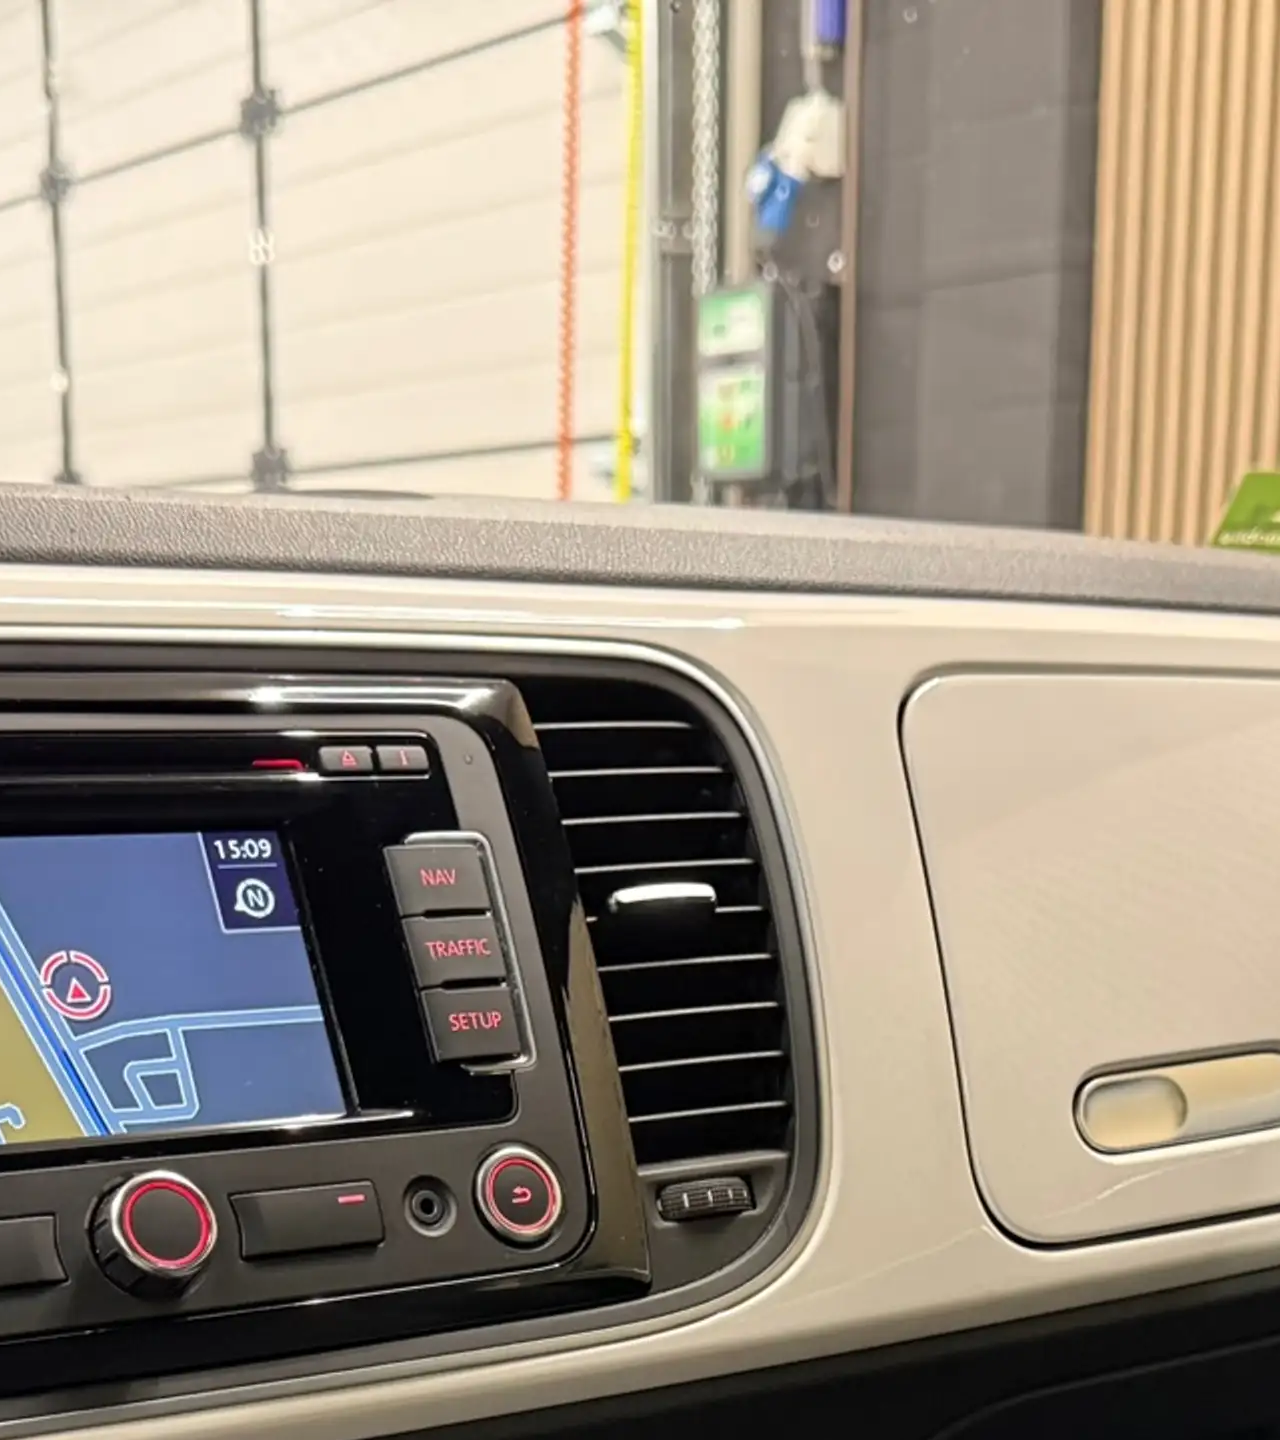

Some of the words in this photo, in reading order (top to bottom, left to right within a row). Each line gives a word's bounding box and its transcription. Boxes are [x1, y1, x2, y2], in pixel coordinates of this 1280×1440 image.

[213, 838, 272, 860] 15:09
[420, 869, 456, 885] NAV
[246, 888, 265, 908] N
[426, 939, 491, 959] TRAFFIC
[450, 1011, 502, 1032] SETUP
